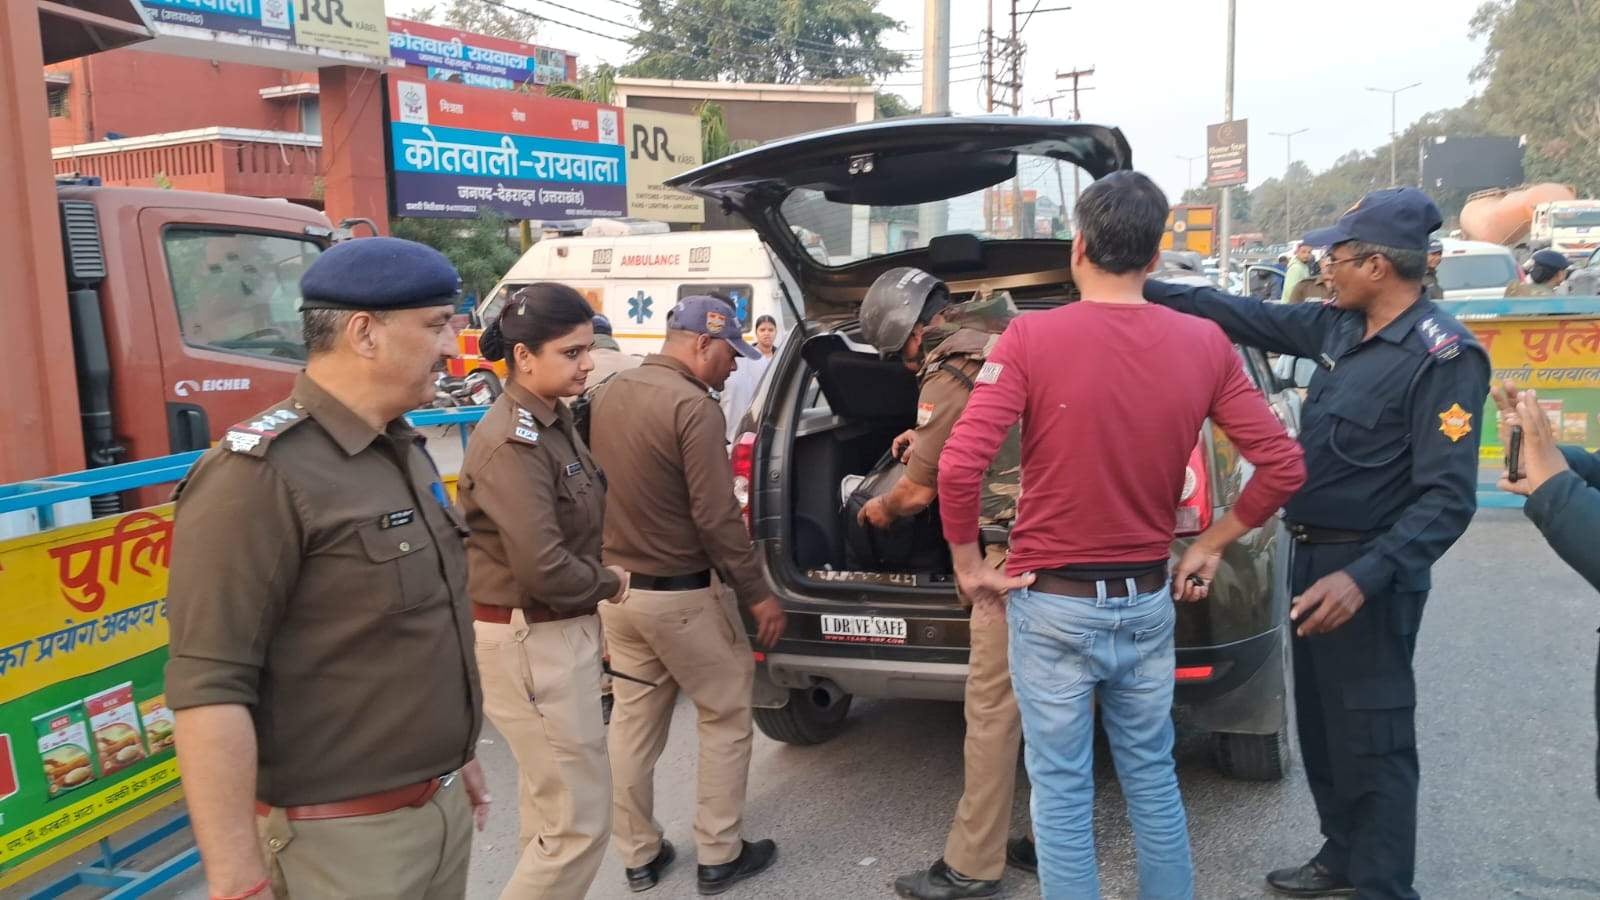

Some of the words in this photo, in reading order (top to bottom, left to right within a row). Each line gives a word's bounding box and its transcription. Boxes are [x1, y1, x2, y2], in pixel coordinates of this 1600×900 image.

[402, 127, 619, 183] कोतवाली-रायवाला
[631, 124, 676, 163] RR
[457, 182, 536, 207] जनपद-देहरादून
[620, 254, 680, 267] AMBULANCE
[1520, 319, 1600, 363] पुलि
[202, 378, 251, 392] EICHER
[48, 511, 175, 613] पुलि
[34, 618, 99, 663] प्रयोग
[833, 618, 871, 634] DRVE
[875, 619, 904, 636] SAFE
